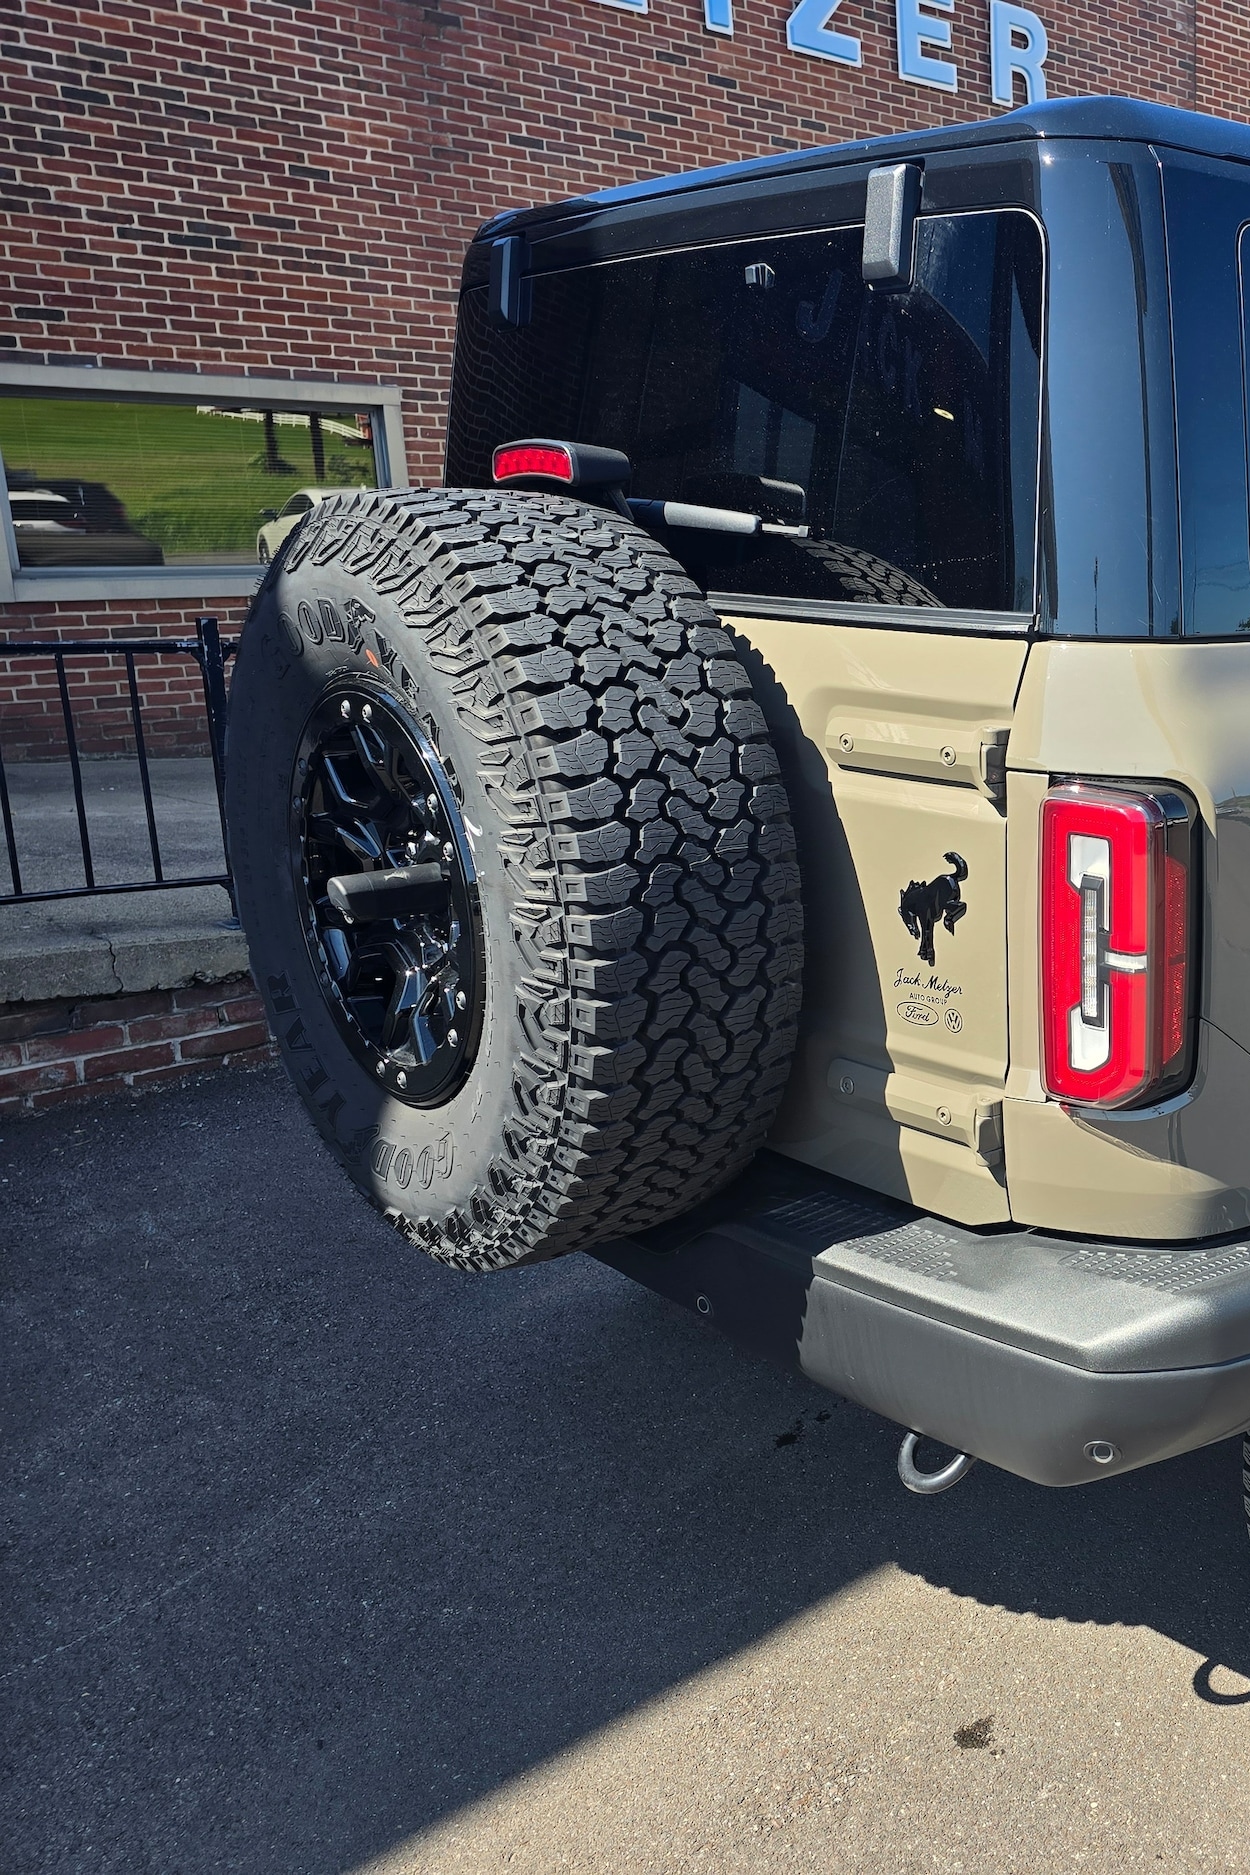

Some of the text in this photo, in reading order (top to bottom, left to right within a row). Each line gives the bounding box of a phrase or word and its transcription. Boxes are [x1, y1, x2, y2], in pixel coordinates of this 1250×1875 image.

[587, 0, 1049, 107] ZER
[894, 968, 963, 999] Jack Metzer
[909, 992, 948, 1006] AUTO GROUP
[905, 1004, 930, 1022] Ford
